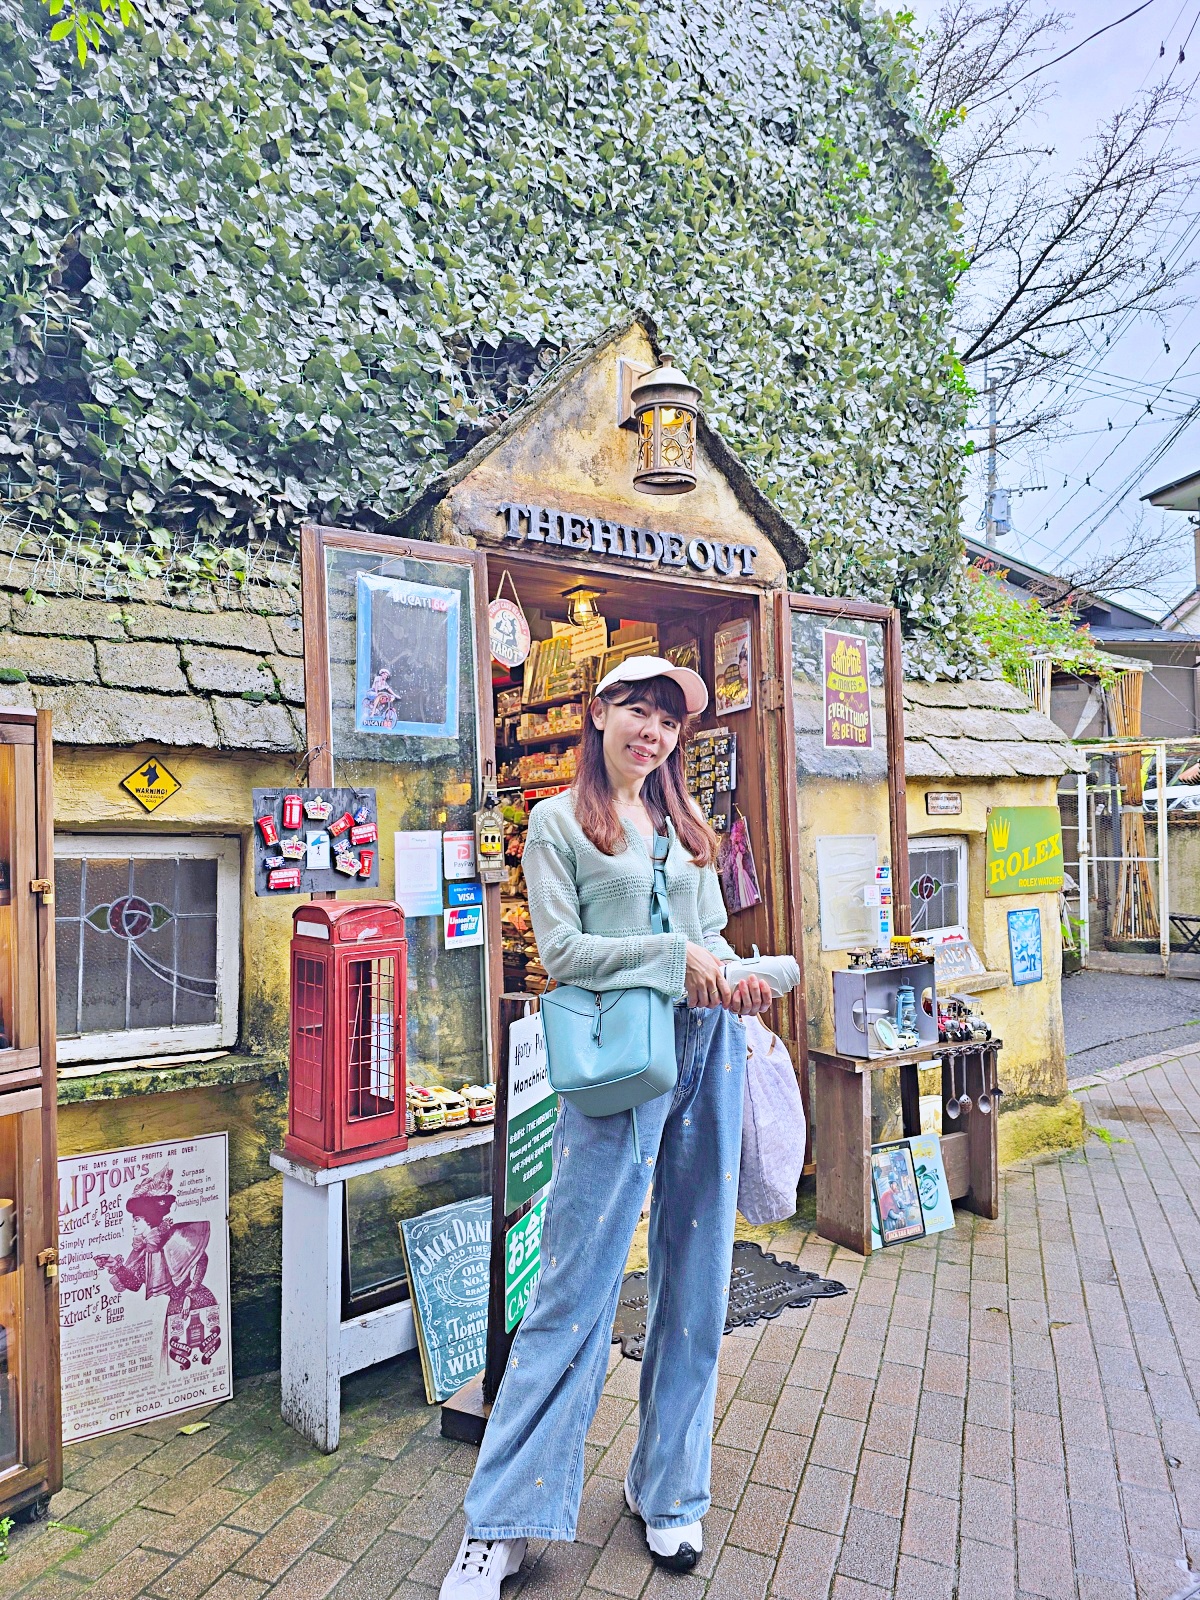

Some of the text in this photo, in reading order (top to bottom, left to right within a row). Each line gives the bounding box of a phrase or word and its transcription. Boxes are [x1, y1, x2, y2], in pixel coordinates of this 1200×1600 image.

[393, 594, 432, 608] DUCATI
[492, 640, 518, 662] TAROT
[831, 653, 862, 676] CAMPING
[837, 678, 857, 691] MAKES
[828, 702, 869, 728] EVERYTHING
[362, 719, 383, 727] DUCATI
[841, 723, 867, 744] BETTER
[537, 786, 558, 797] TOMICA
[454, 860, 475, 868] PayPay
[990, 832, 1062, 884] ROLEX
[1018, 876, 1063, 888] ROLEX WATCHES
[457, 893, 475, 902] VISA
[450, 915, 478, 925] UnionPay
[514, 1034, 546, 1066] Harry Po
[94, 1161, 107, 1169] DAYS
[124, 1156, 137, 1164] HUGE
[142, 1152, 162, 1160] PROFITS
[182, 1146, 198, 1154] OVER!
[181, 1168, 205, 1177] Surpass
[58, 1163, 150, 1216] LIPTON'S
[176, 1187, 204, 1197] Stimulating
[91, 1208, 98, 1221] of
[100, 1194, 122, 1216] Beef
[174, 1198, 200, 1212] Nourishing
[105, 1210, 124, 1220] FLUID
[104, 1218, 124, 1228] BEEF
[59, 1227, 124, 1250] Simply perfection!
[414, 1219, 492, 1276] JACK DANI
[448, 1245, 490, 1263] OLD TIME
[68, 1252, 93, 1266] Delicious
[60, 1268, 98, 1285] Strengthening
[462, 1262, 485, 1277] Old
[466, 1283, 490, 1296] BRAND
[92, 1301, 100, 1314] of
[100, 1292, 122, 1310] Beef
[95, 1306, 124, 1323] & FLUID
[202, 1332, 217, 1347] FLUID
[170, 1341, 192, 1353] EXTRACT
[448, 1337, 483, 1357] SOUR
[192, 1354, 199, 1362] &
[64, 1372, 80, 1383] LIPTON
[102, 1370, 121, 1380] EXTRACT
[193, 1374, 210, 1382] EVERY
[80, 1398, 100, 1408] PUBLIC
[103, 1392, 126, 1402] VERDICT
[109, 1409, 131, 1421] CITY
[212, 1383, 227, 1393] E.C.
